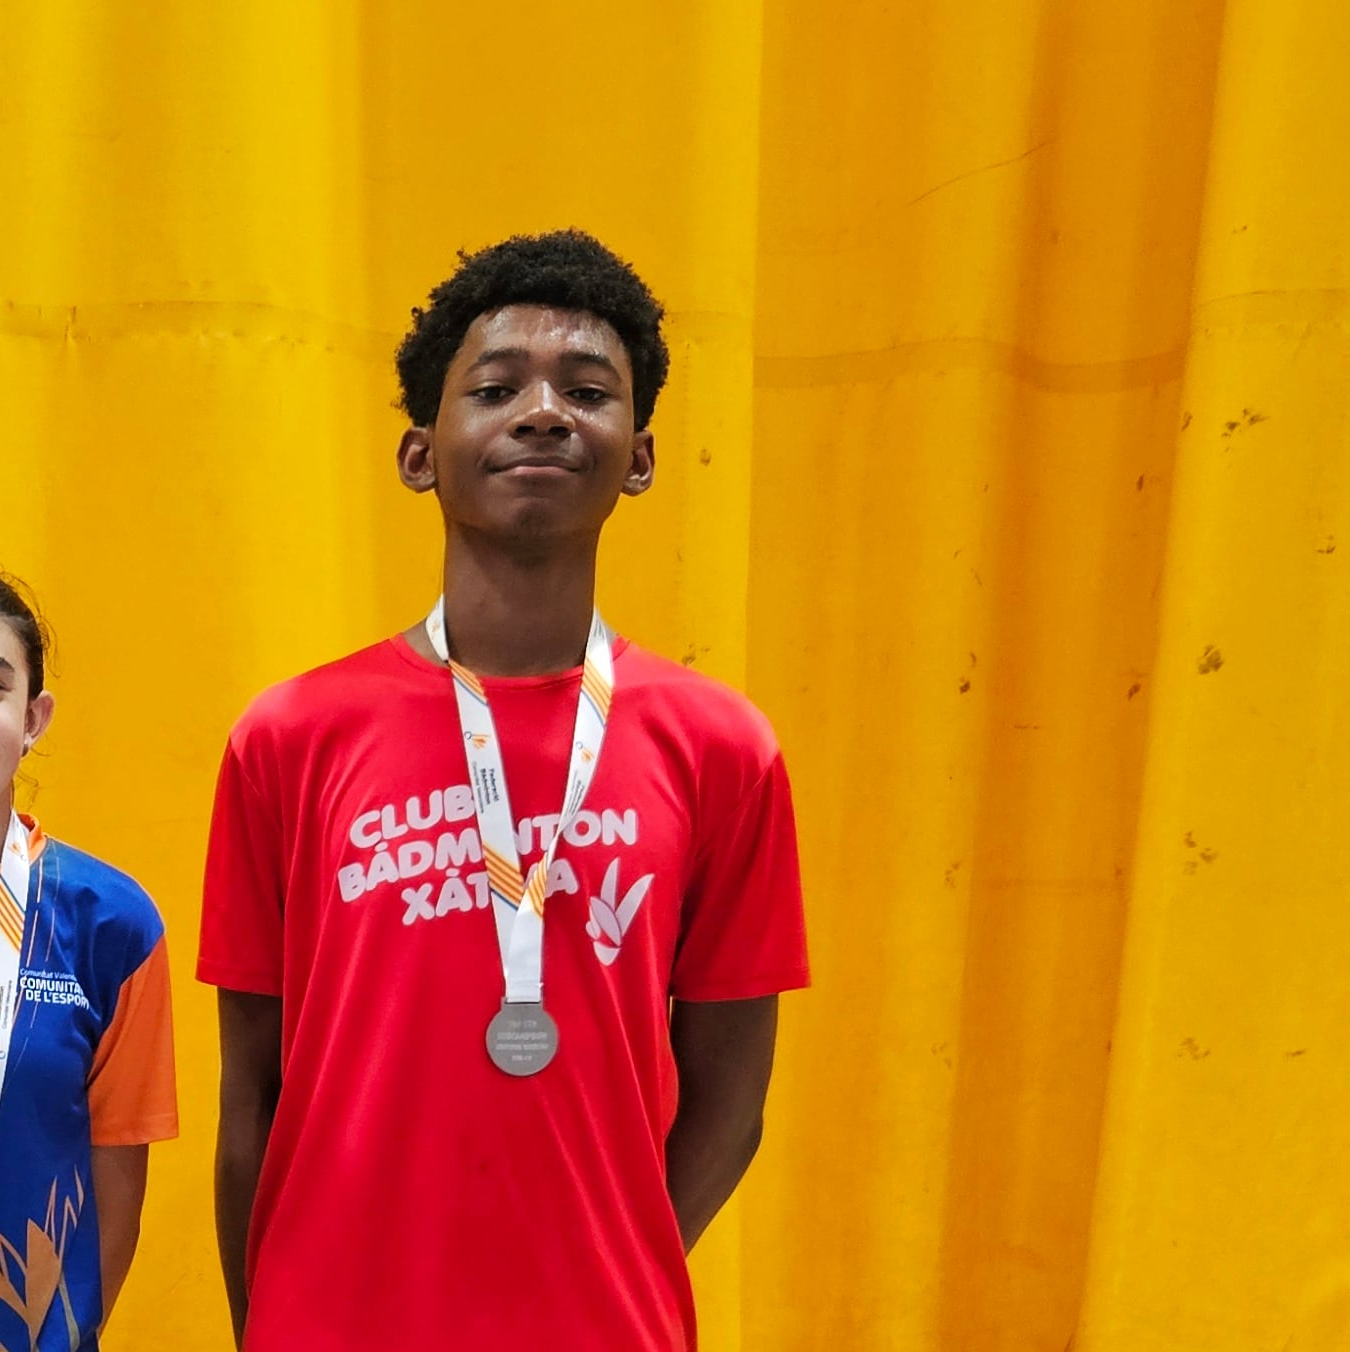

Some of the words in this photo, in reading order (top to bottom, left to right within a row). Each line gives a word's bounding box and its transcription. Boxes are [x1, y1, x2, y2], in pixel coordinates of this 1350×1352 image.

[350, 784, 475, 848] CLUB
[401, 858, 579, 926] XÀTA
[25, 989, 41, 1002] DE
